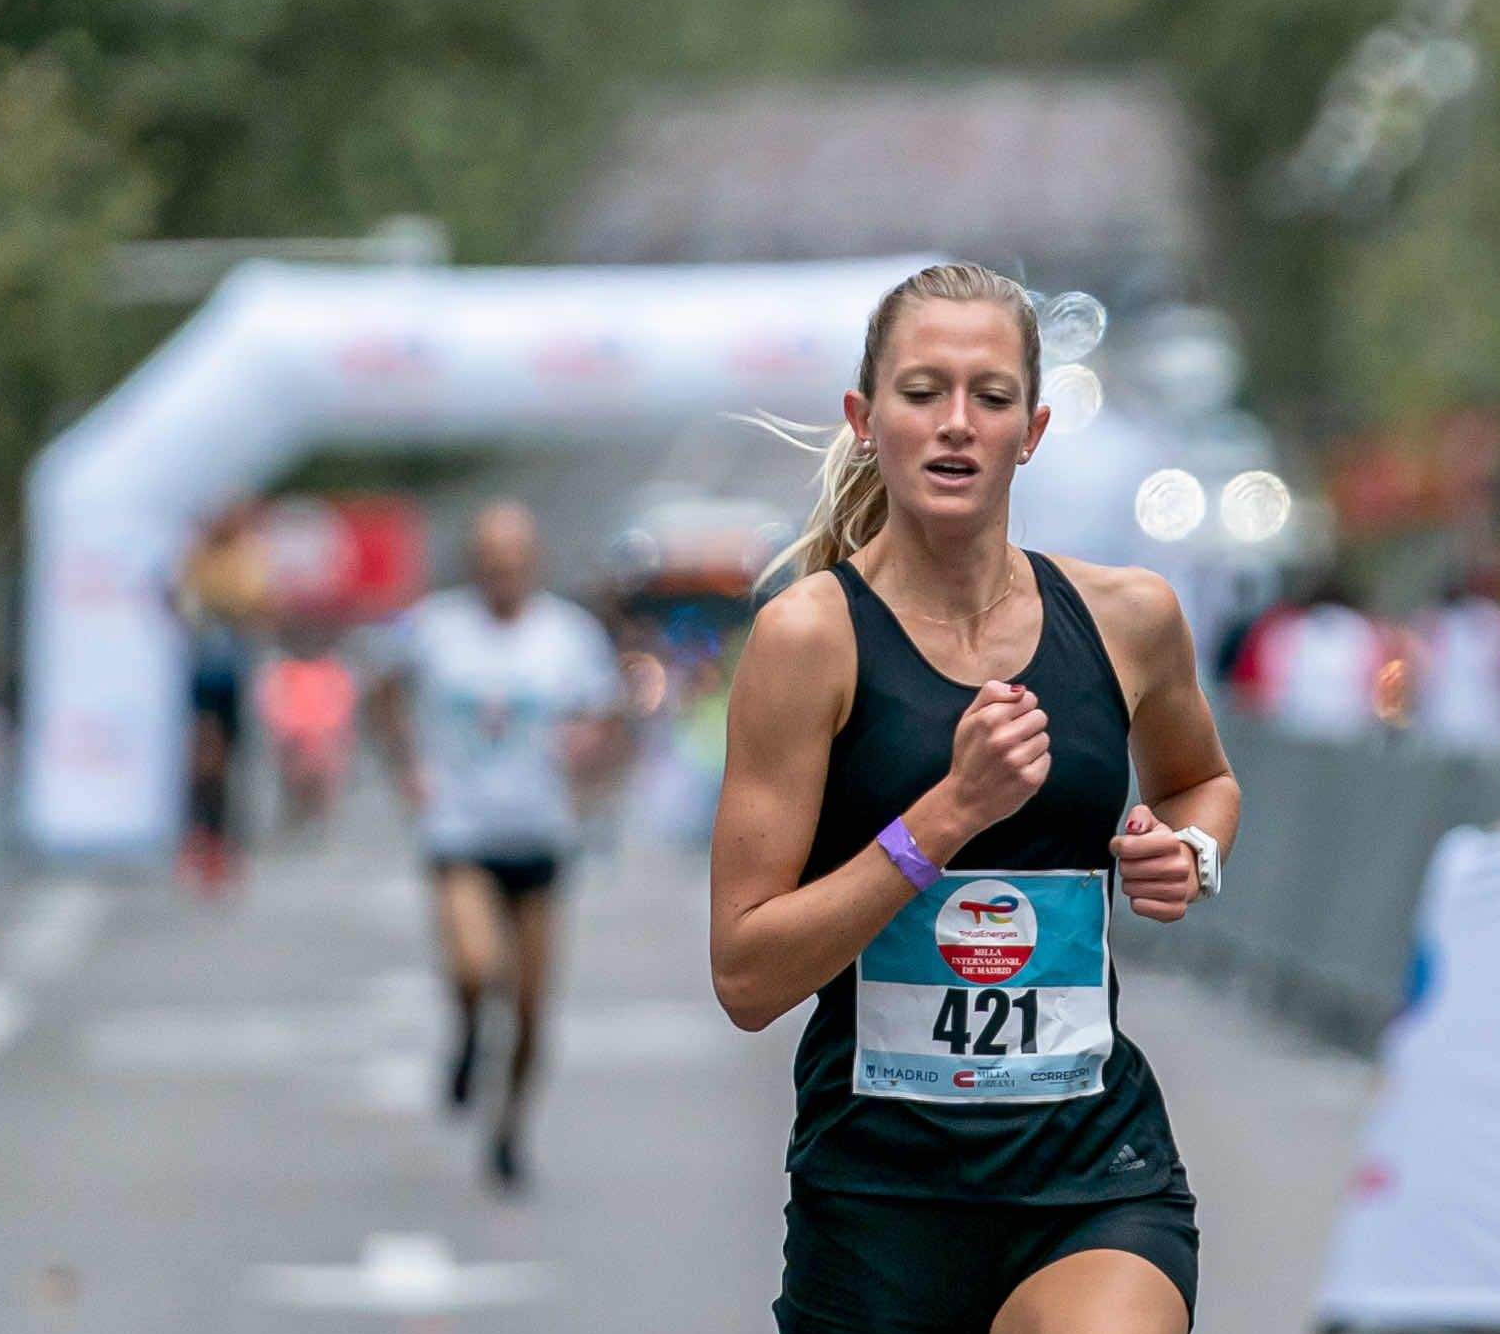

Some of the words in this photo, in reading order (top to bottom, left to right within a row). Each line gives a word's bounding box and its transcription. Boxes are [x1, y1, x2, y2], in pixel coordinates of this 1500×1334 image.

[974, 948, 1002, 956] MILLA
[962, 966, 975, 975] DE
[977, 966, 1012, 975] MADRID
[932, 988, 1039, 1055] 421
[883, 1068, 939, 1083] MADRID
